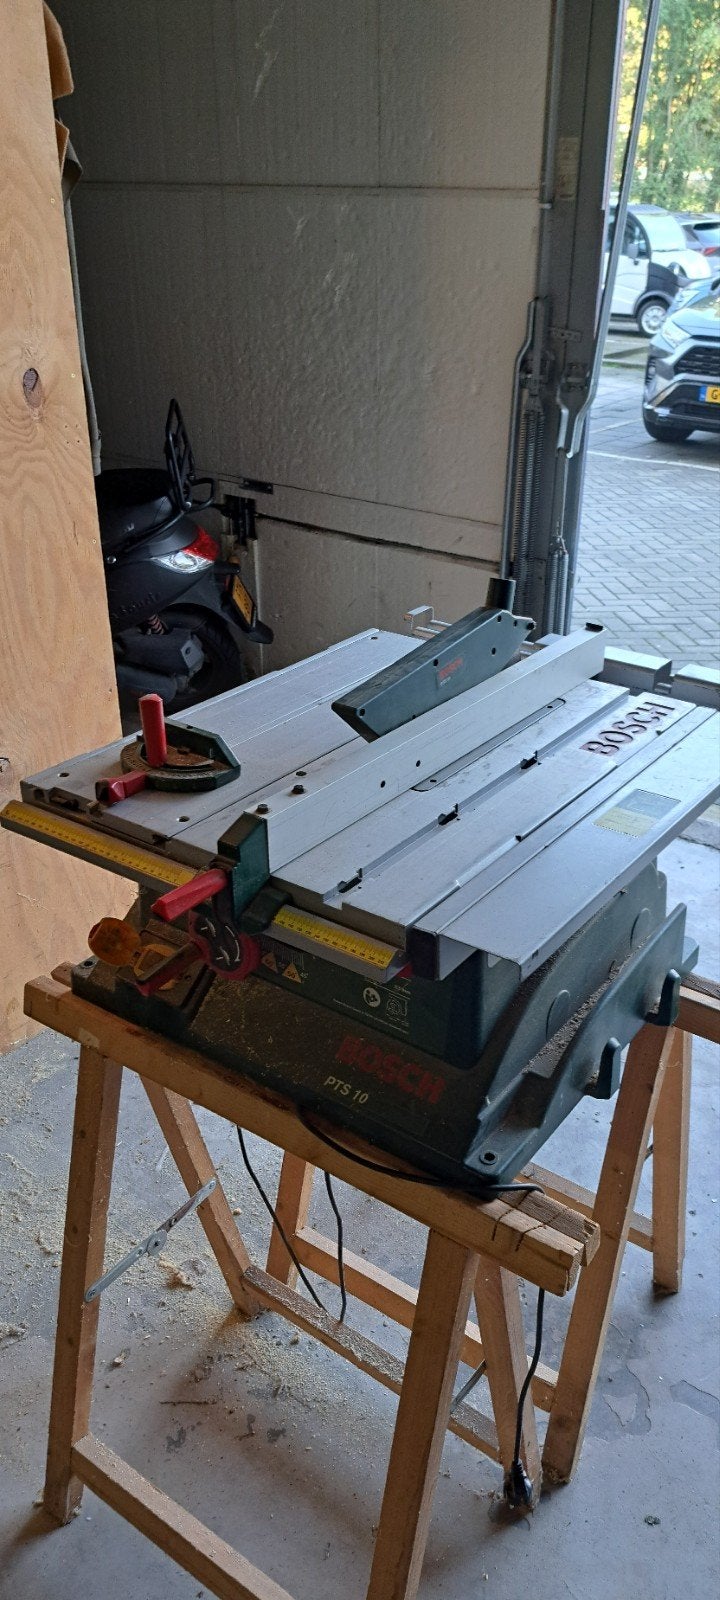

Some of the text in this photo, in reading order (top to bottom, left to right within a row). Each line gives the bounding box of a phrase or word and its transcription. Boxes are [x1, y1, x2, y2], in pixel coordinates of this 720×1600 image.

[579, 701, 675, 756] BOSCH
[323, 1075, 369, 1104] PTS 10
[335, 1034, 446, 1104] BOSCH
